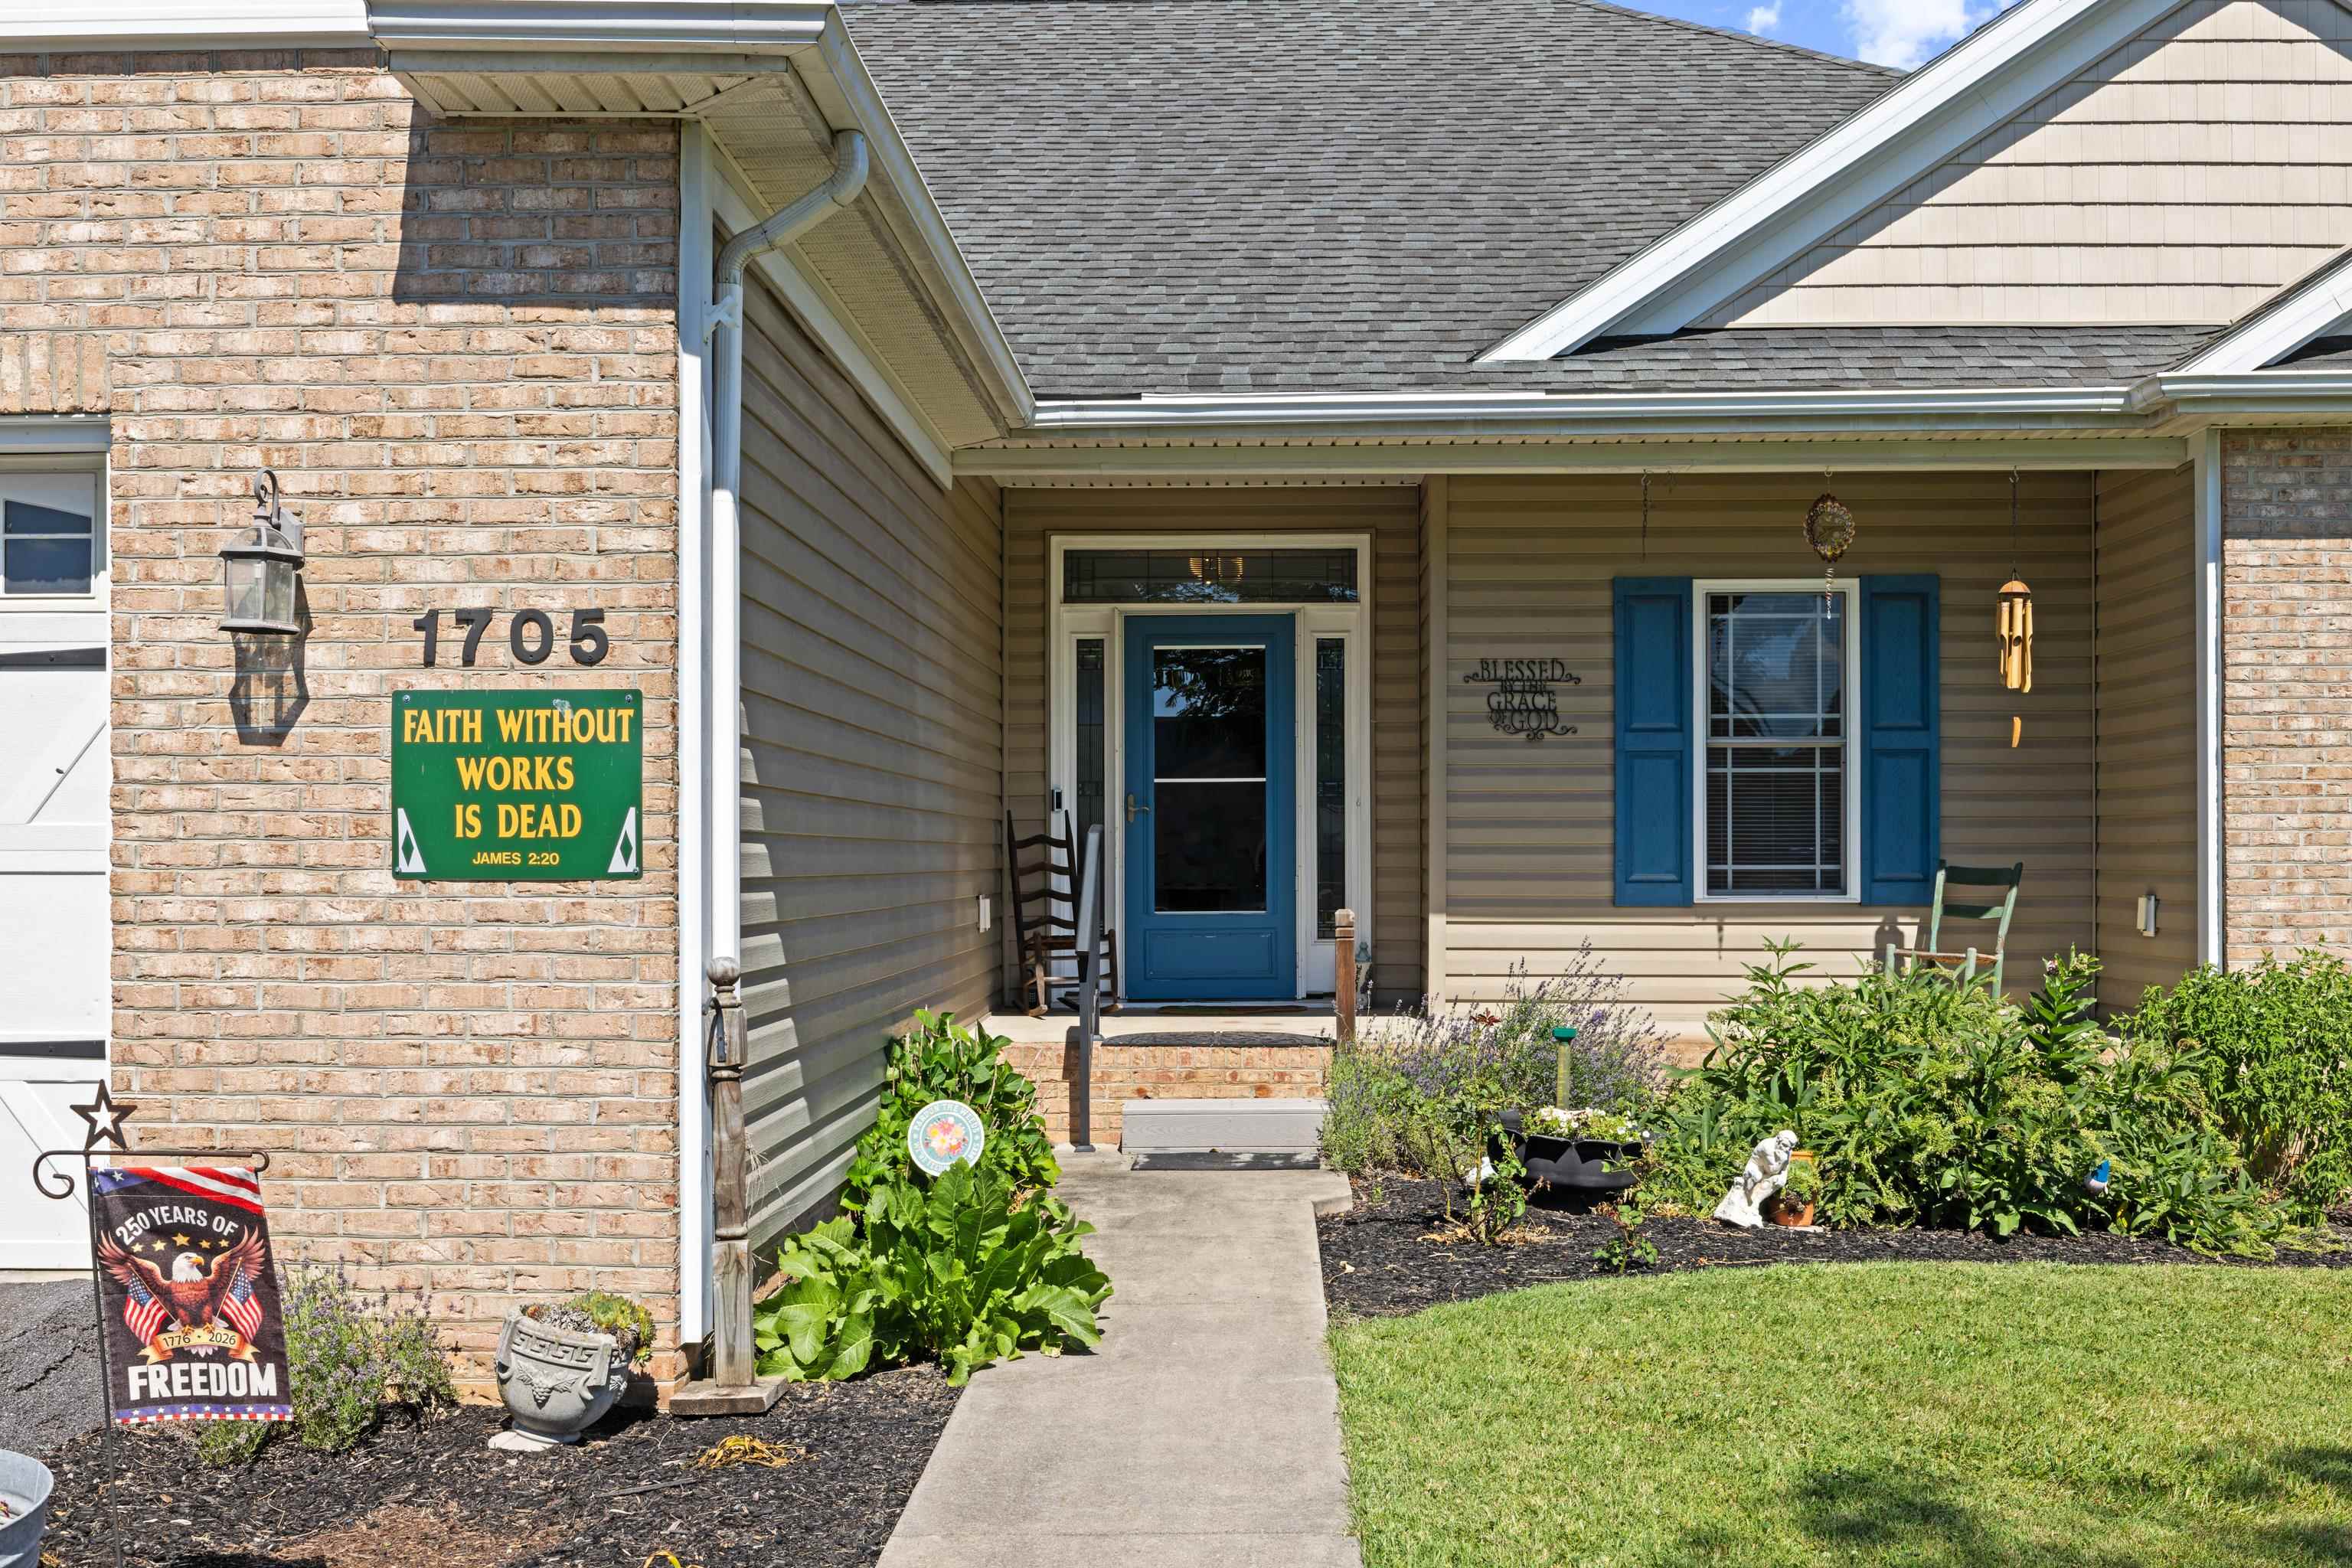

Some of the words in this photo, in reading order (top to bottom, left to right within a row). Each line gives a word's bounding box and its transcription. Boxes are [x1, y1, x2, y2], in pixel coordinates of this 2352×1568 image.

[413, 608, 609, 668] 1705
[1480, 658, 1565, 681] BLESSED
[1487, 691, 1557, 711] GRACE
[404, 710, 482, 742] FAITH
[496, 708, 634, 743] WITHOUT
[1490, 710, 1508, 724] OF
[1511, 710, 1559, 730] GOD
[456, 756, 573, 790] WORKS
[456, 805, 481, 838] IS
[498, 805, 581, 838] DEAD
[473, 852, 521, 864] JAMES
[529, 853, 559, 864] 2:20
[116, 1211, 150, 1246] 250
[150, 1205, 207, 1227] YEARS
[212, 1216, 238, 1236] OF
[162, 1334, 191, 1348] 1776
[208, 1333, 237, 1346] 2026
[128, 1362, 277, 1400] FREEDOM
